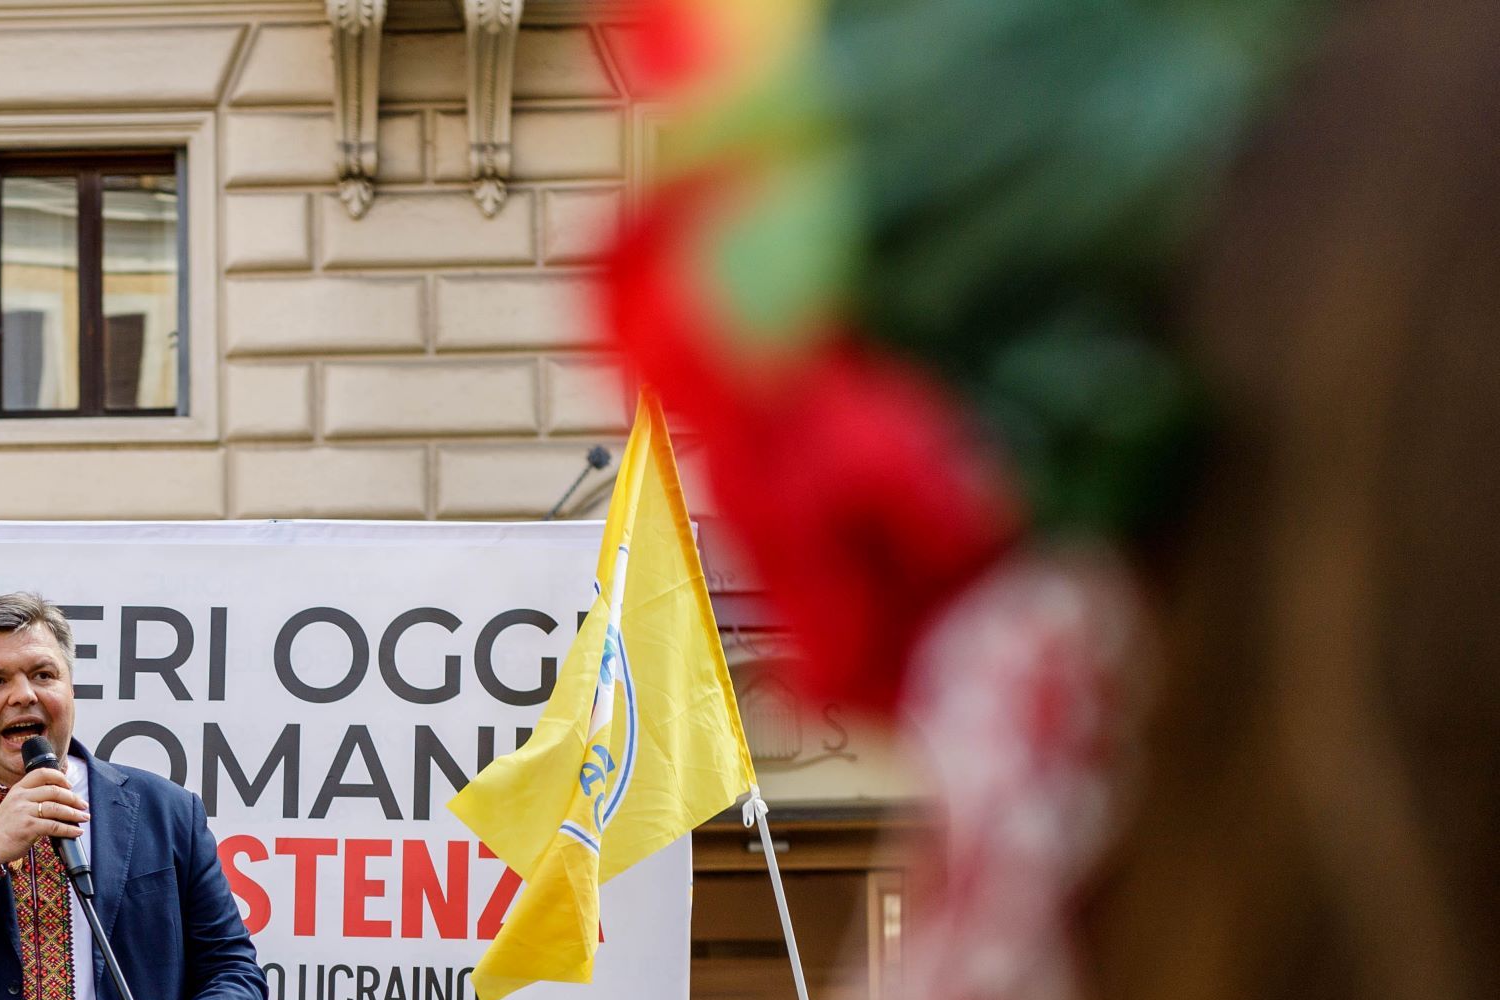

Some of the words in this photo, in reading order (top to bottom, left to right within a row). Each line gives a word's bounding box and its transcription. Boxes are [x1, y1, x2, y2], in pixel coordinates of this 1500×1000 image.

[56, 605, 228, 702] ERI
[273, 607, 590, 707] OGG
[93, 719, 533, 824] OMAN
[216, 834, 605, 943] STENZ
